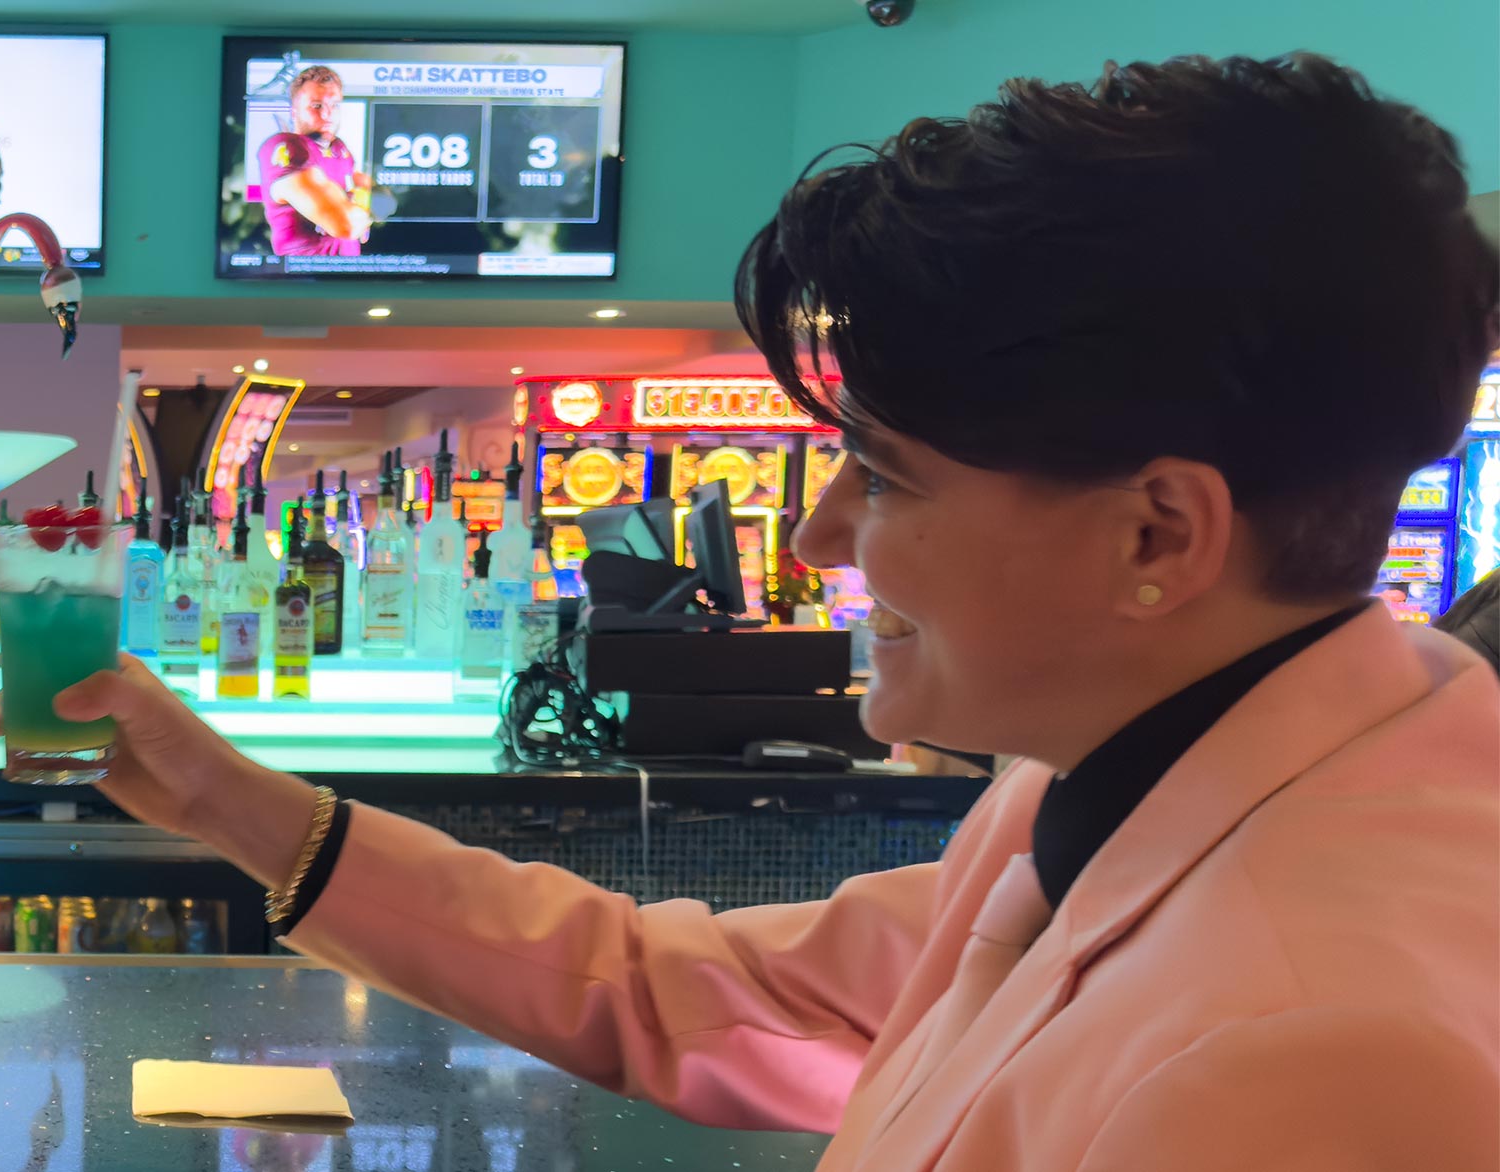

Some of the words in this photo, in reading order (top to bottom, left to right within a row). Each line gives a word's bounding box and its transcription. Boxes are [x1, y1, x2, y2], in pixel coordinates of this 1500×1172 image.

[374, 66, 422, 82] CAM
[427, 68, 547, 83] SKATTEBO
[536, 88, 565, 97] STATE
[383, 134, 471, 169] 208
[527, 135, 559, 170] 3
[376, 170, 439, 186] SCRIMMAGE
[440, 171, 475, 187] YARDS
[519, 171, 549, 187] TOTAL
